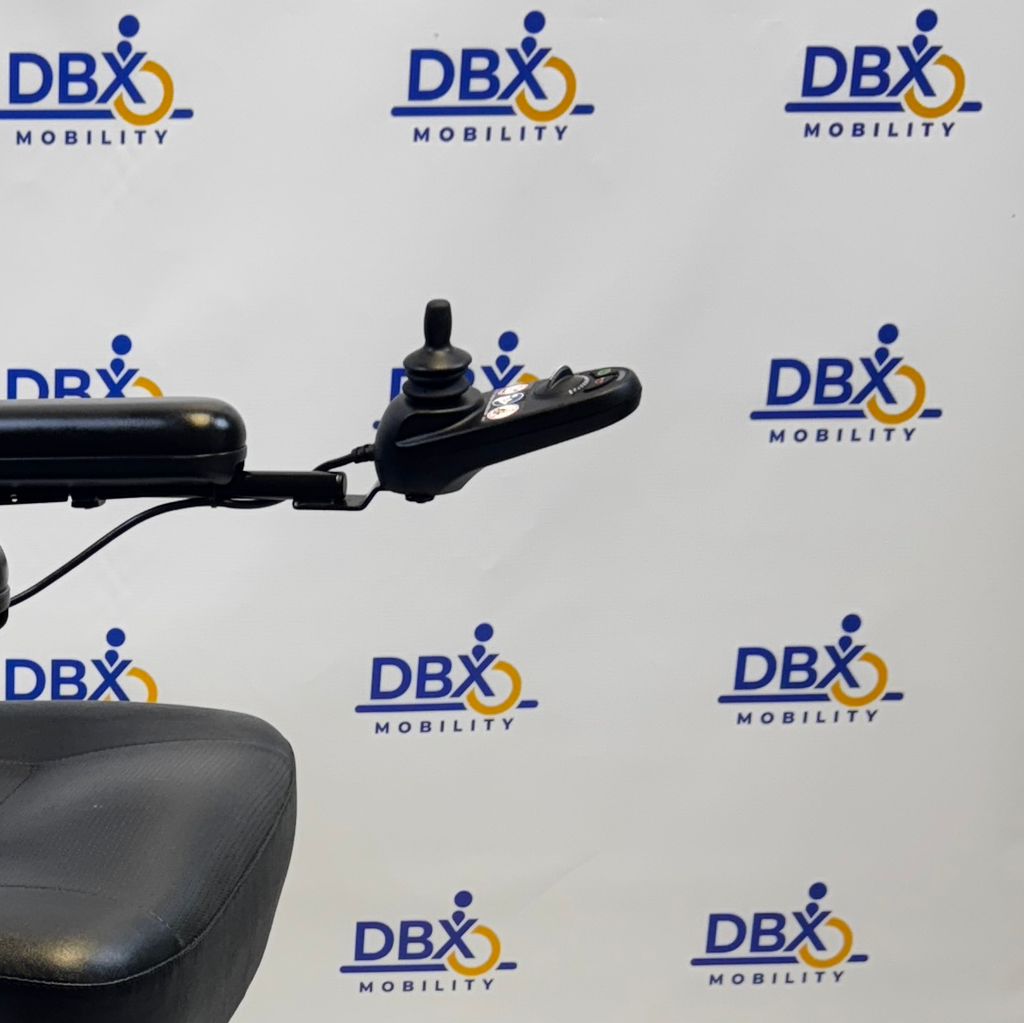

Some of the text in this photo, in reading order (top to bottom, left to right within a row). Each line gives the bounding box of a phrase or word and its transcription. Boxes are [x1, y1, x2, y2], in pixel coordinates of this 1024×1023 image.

[9, 52, 147, 104] DBX
[408, 48, 551, 101] DBX
[801, 46, 942, 97] DBX
[16, 130, 167, 145] MOBILITY
[414, 126, 567, 142] MOBILITY
[804, 122, 955, 137] MOBILITY
[766, 357, 903, 406] DBX
[769, 428, 916, 443] MOBILITY
[5, 659, 132, 701] DBX
[370, 654, 499, 700] DBX
[734, 645, 865, 690] DBX
[375, 718, 513, 734] MOBILITY
[737, 710, 877, 724] MOBILITY
[354, 919, 478, 961] DBX
[706, 911, 831, 953] DBX
[360, 979, 493, 992] MOBILITY
[709, 971, 844, 985] MOBILITY
